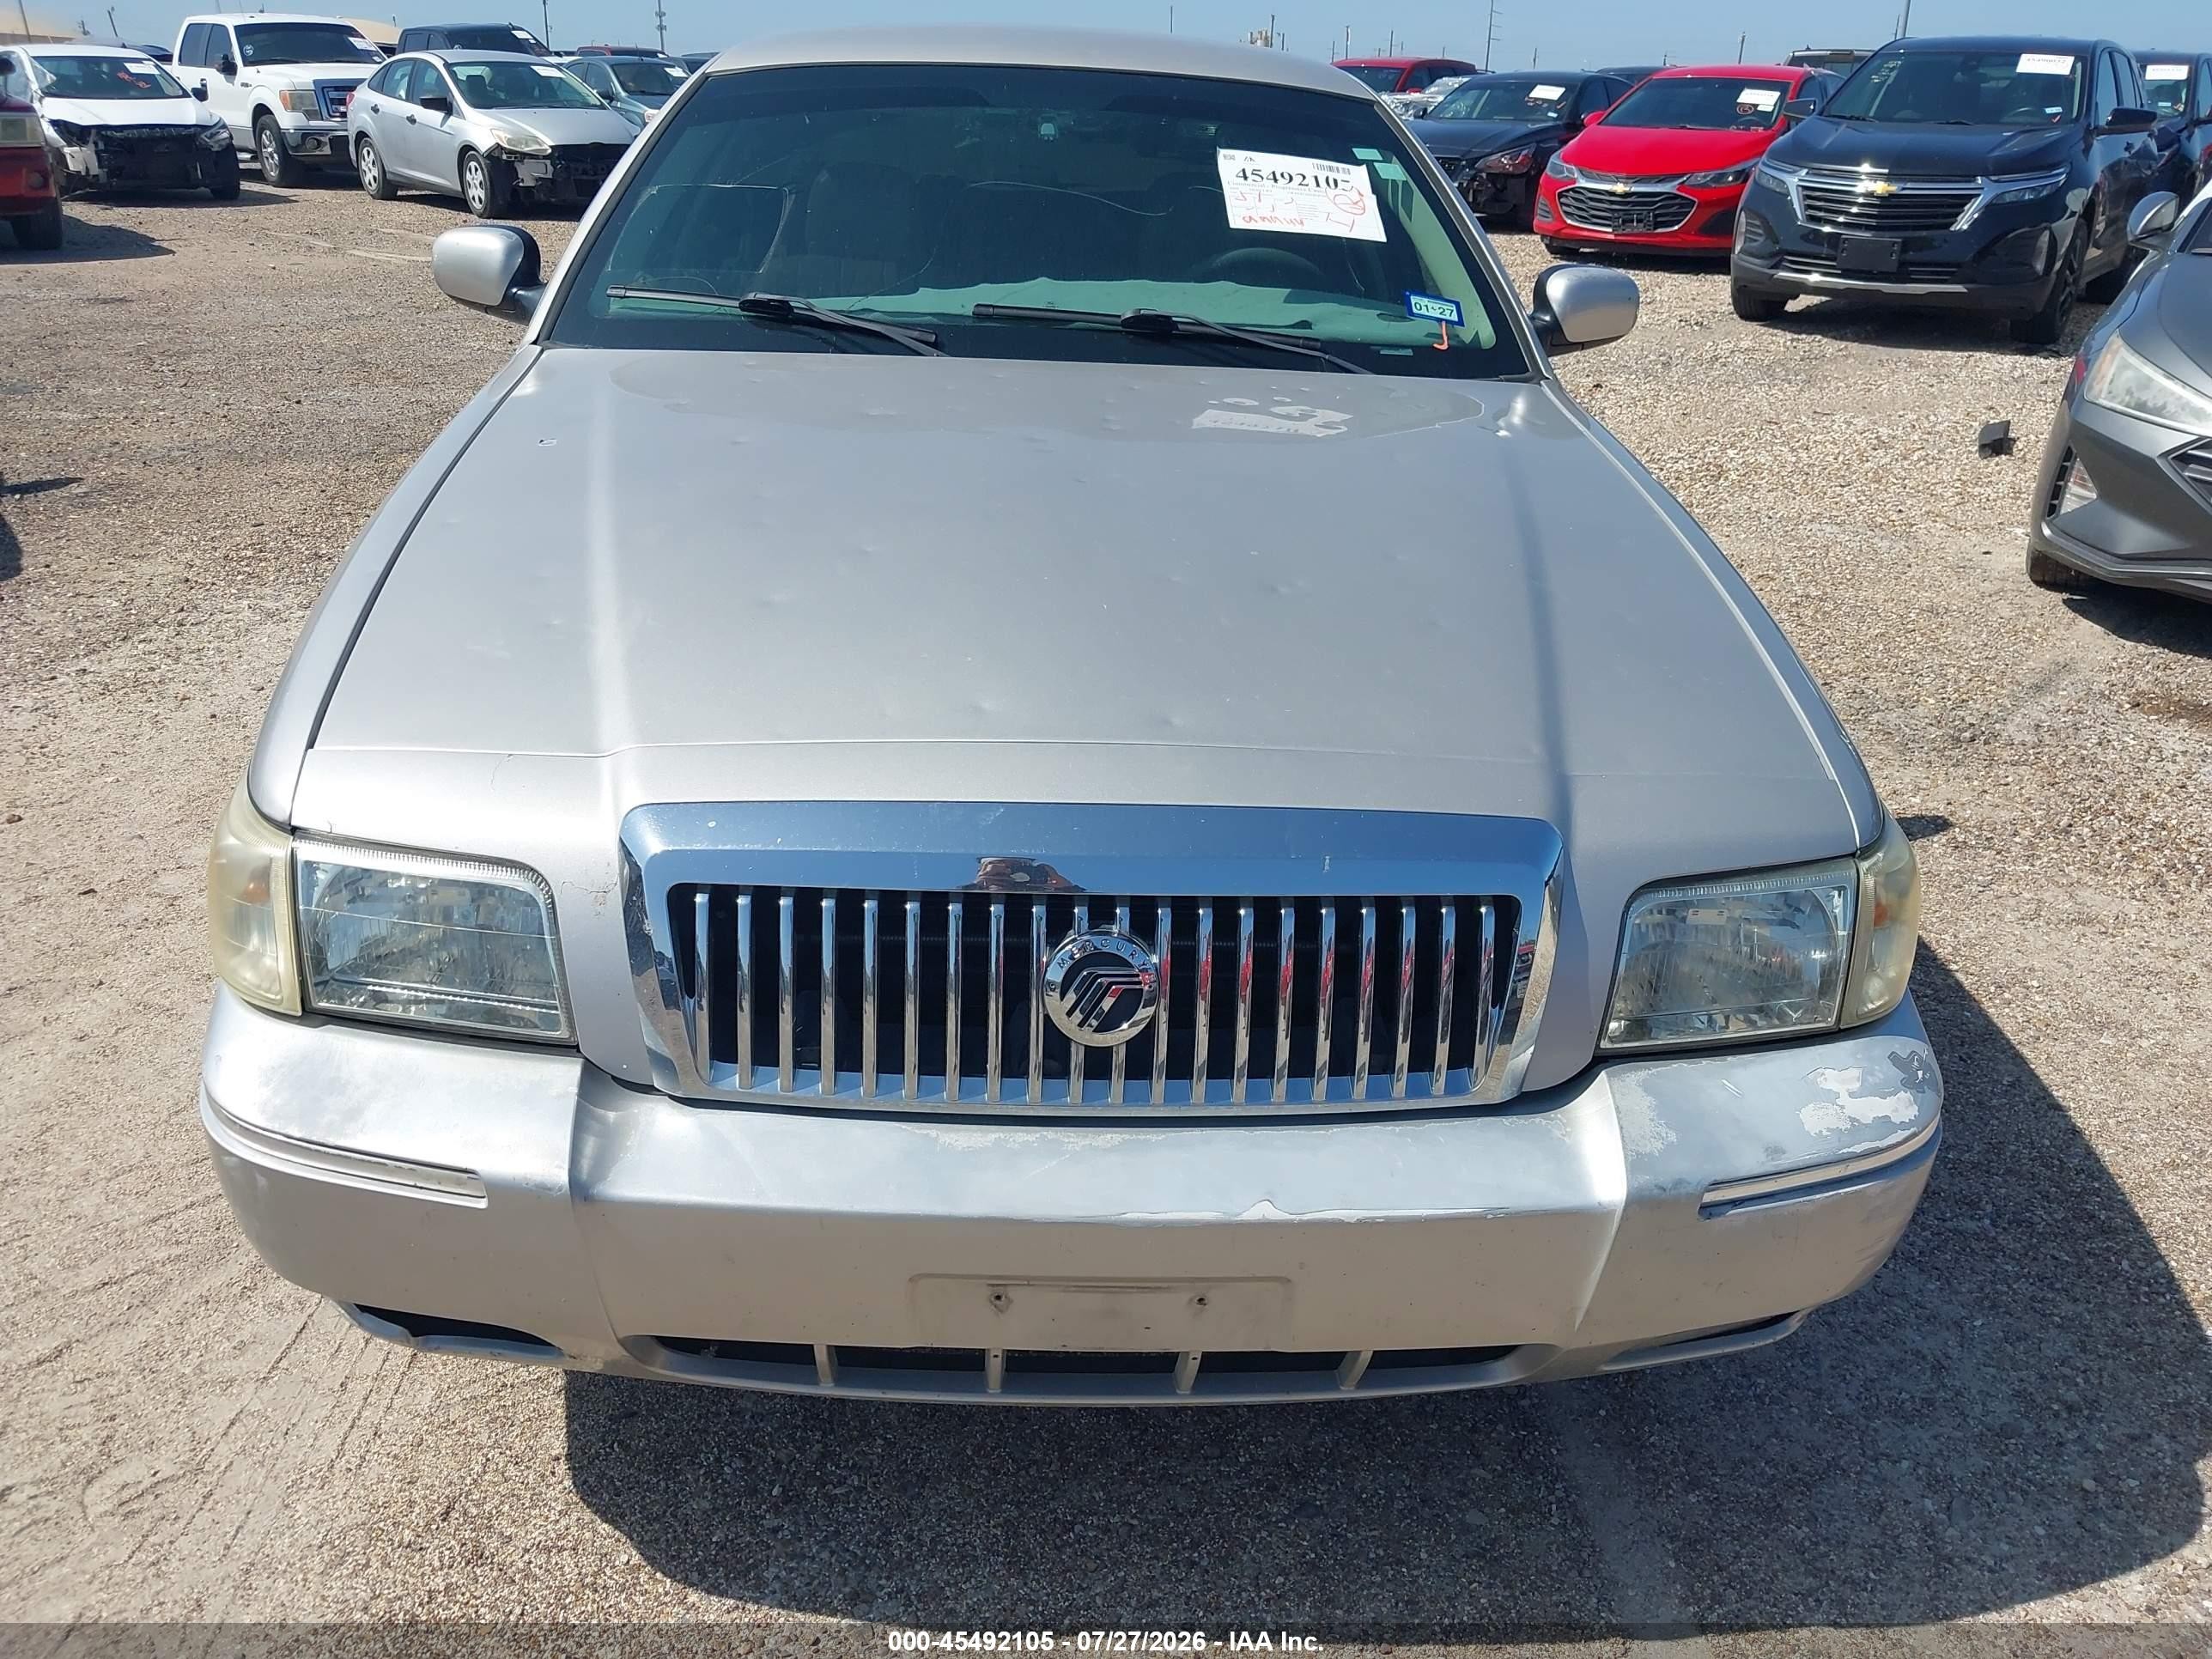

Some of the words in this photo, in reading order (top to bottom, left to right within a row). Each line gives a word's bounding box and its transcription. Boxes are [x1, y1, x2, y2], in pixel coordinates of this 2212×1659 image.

[1235, 167, 1354, 192] 45492105
[1414, 301, 1454, 317] 01-27
[1056, 938, 1149, 970] MERCURY
